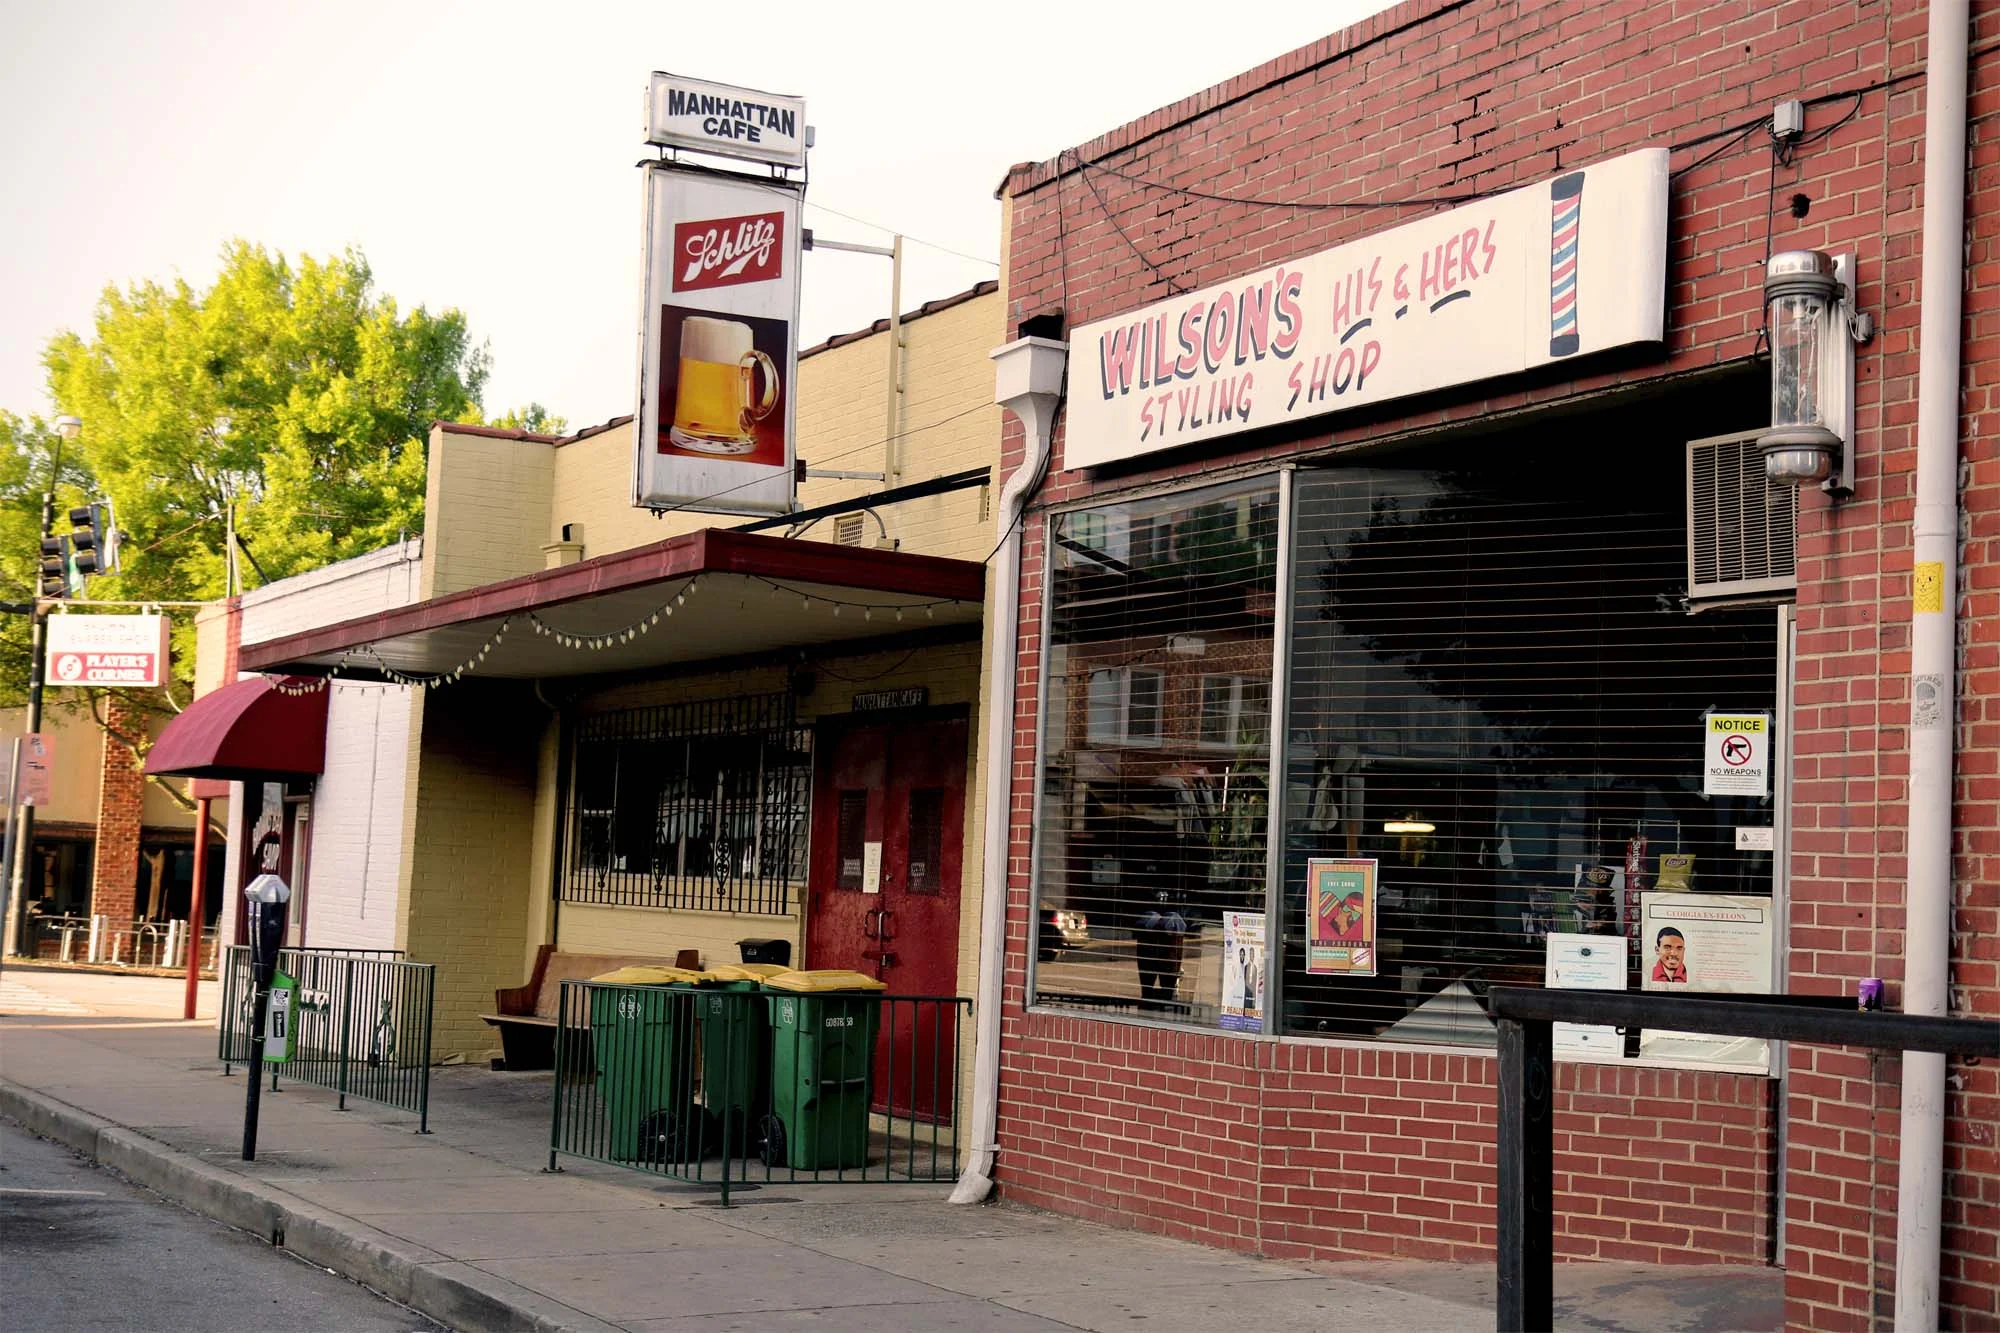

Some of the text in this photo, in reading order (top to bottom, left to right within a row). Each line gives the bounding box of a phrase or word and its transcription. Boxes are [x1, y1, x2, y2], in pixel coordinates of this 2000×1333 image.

[668, 88, 795, 139] MANHATTAN
[703, 117, 761, 143] CAFE
[682, 218, 775, 283] Schlitz
[1100, 218, 1497, 401] WILSON'S HIS & HERS
[1140, 340, 1382, 443] STYLING SHOP
[87, 668, 147, 681] CORNER
[1714, 720, 1761, 731] NOTICE
[1724, 768, 1762, 776] WEAPONS
